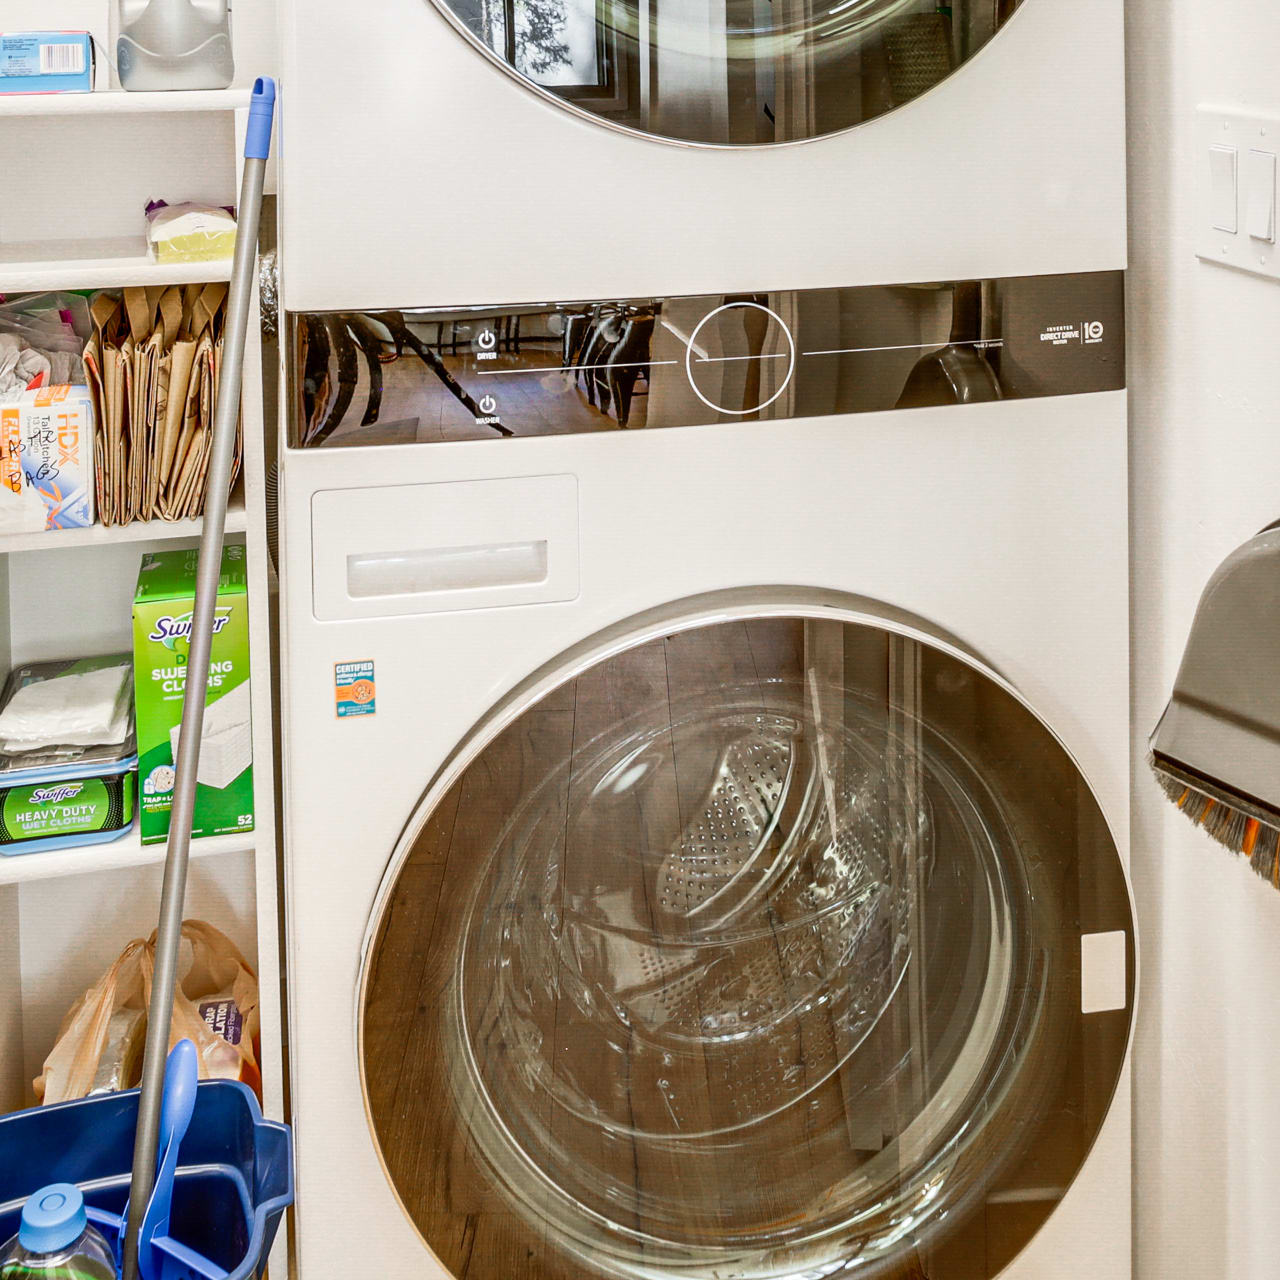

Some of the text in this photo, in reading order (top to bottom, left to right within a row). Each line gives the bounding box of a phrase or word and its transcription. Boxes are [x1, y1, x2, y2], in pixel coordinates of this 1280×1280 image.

[1040, 330, 1079, 341] DIRECT DRIVE
[1084, 321, 1104, 339] 10
[477, 352, 497, 360] DRYER
[475, 417, 501, 425] WASHER
[56, 412, 80, 467] HDX
[8, 459, 60, 492] BAGS
[151, 661, 233, 681] SWENG
[336, 662, 374, 674] CERTIFIED
[162, 675, 222, 693] CLHS
[30, 788, 79, 803] Swiffer
[143, 796, 161, 804] TRAP
[16, 805, 97, 823] HEAVY DUTY
[237, 814, 253, 825] 52
[22, 820, 47, 830] WET
[50, 816, 92, 827] CLOTHS
